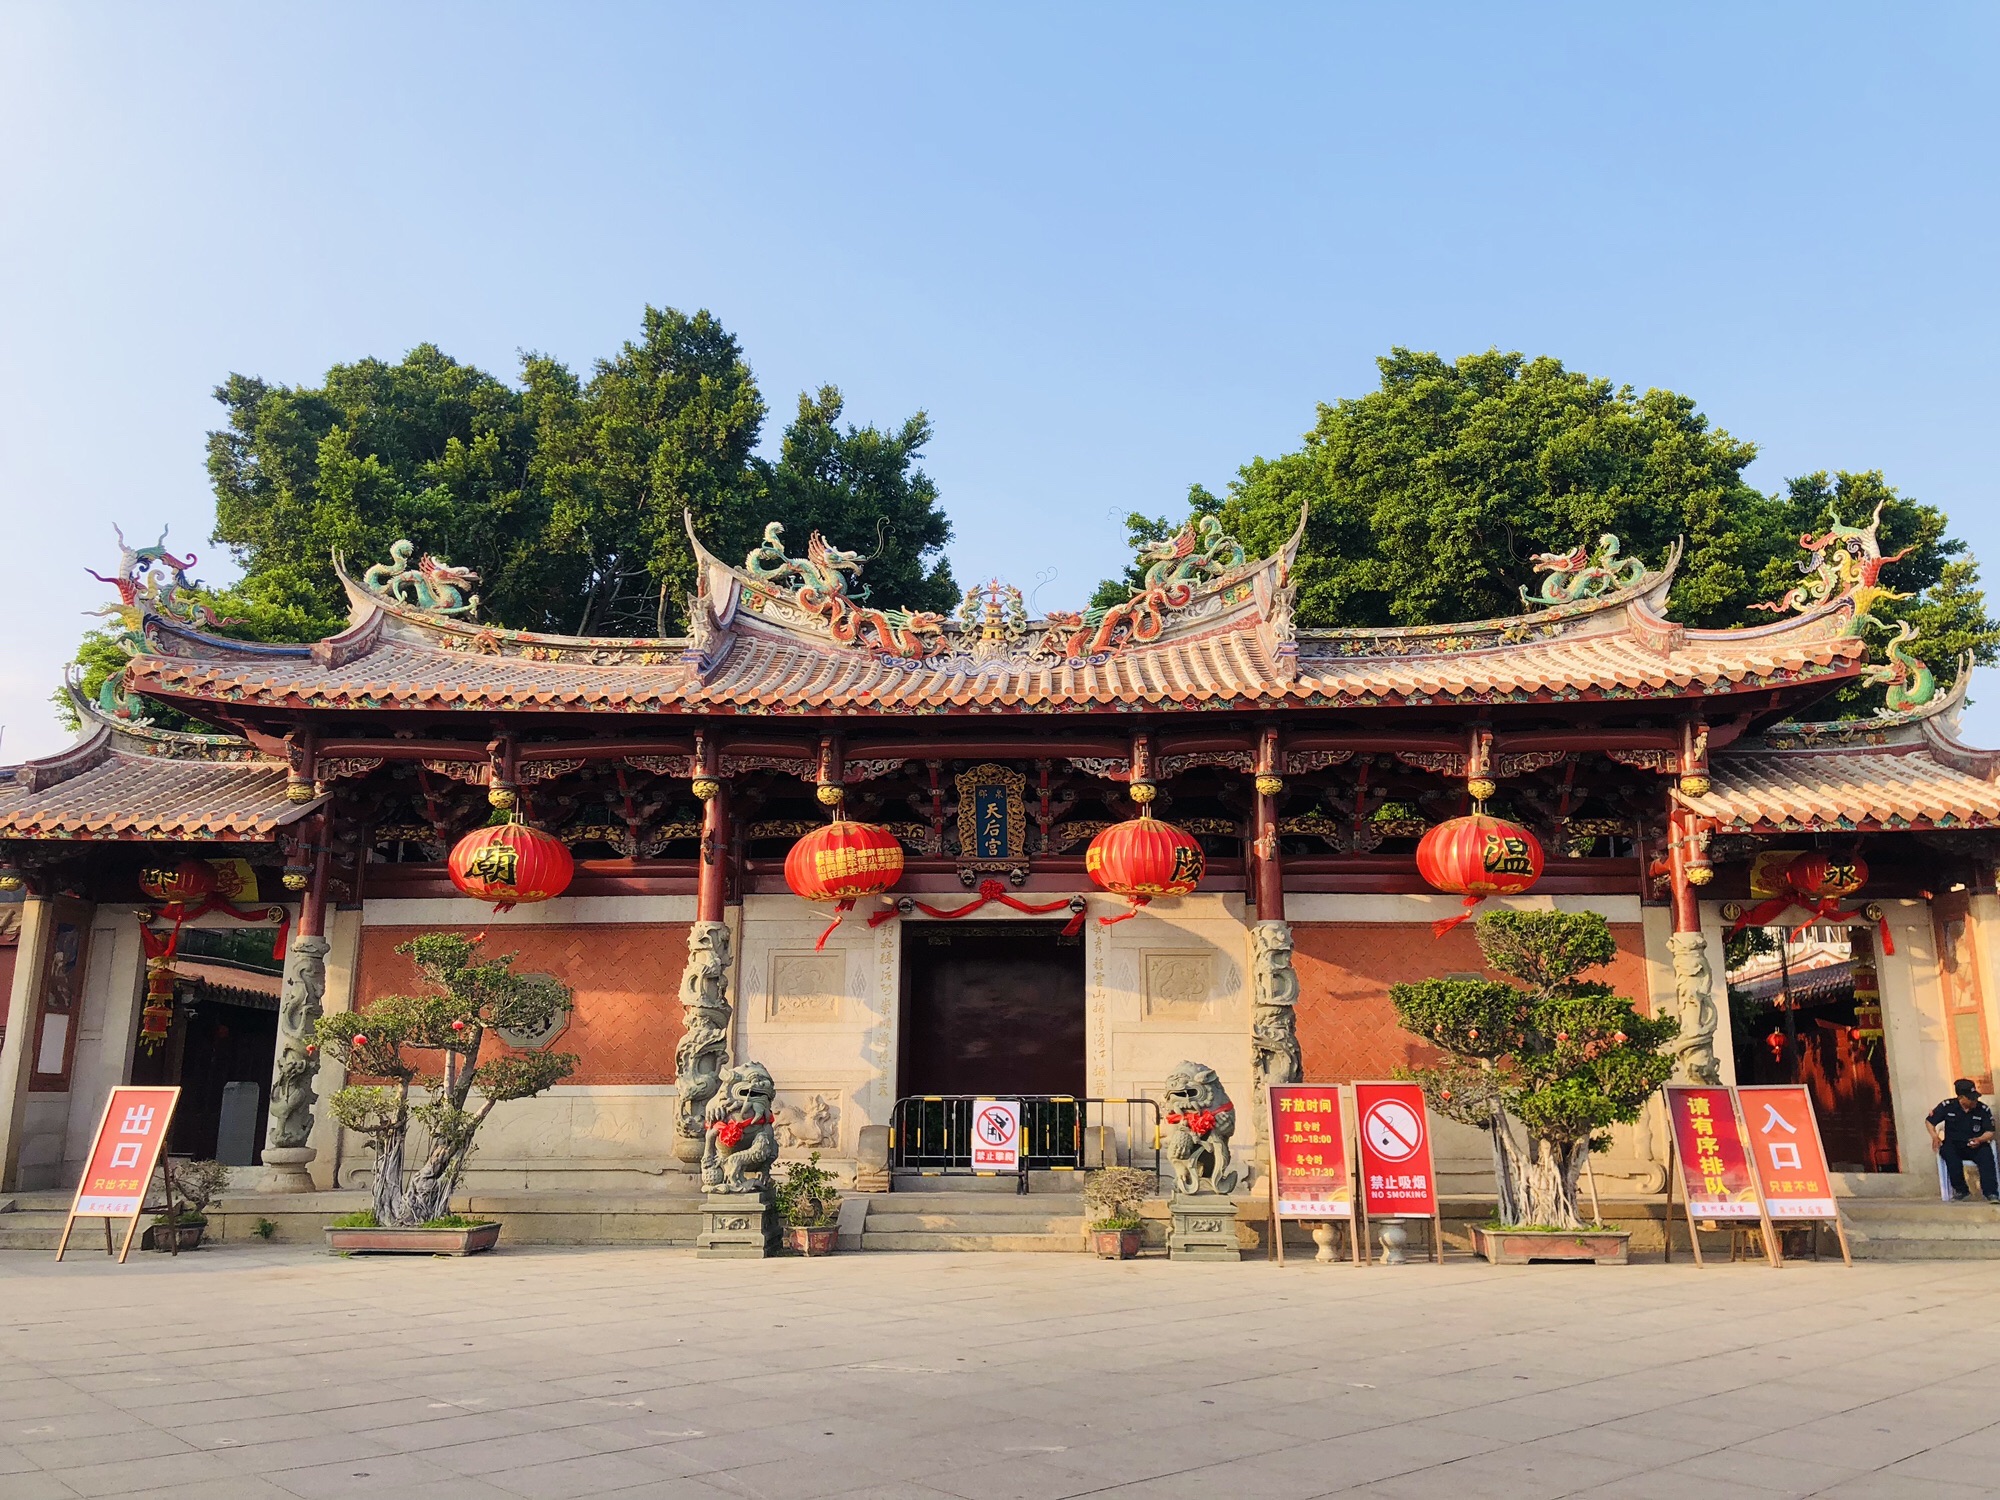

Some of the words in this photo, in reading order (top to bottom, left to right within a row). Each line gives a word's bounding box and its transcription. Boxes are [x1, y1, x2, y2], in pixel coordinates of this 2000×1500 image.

[1280, 1098, 1332, 1113] 开放时间
[1294, 1121, 1321, 1132] 夏令时
[109, 1104, 155, 1169] 出口
[1761, 1103, 1802, 1170] 入口
[1686, 1096, 1731, 1196] 请有序排队
[1296, 1154, 1323, 1165] 冬令时
[93, 1178, 139, 1191] 只出不进
[1370, 1175, 1427, 1190] 禁止吸烟
[1769, 1180, 1818, 1193] 只进不出
[1371, 1191, 1384, 1199] NO
[1386, 1191, 1427, 1199] SMOKING
